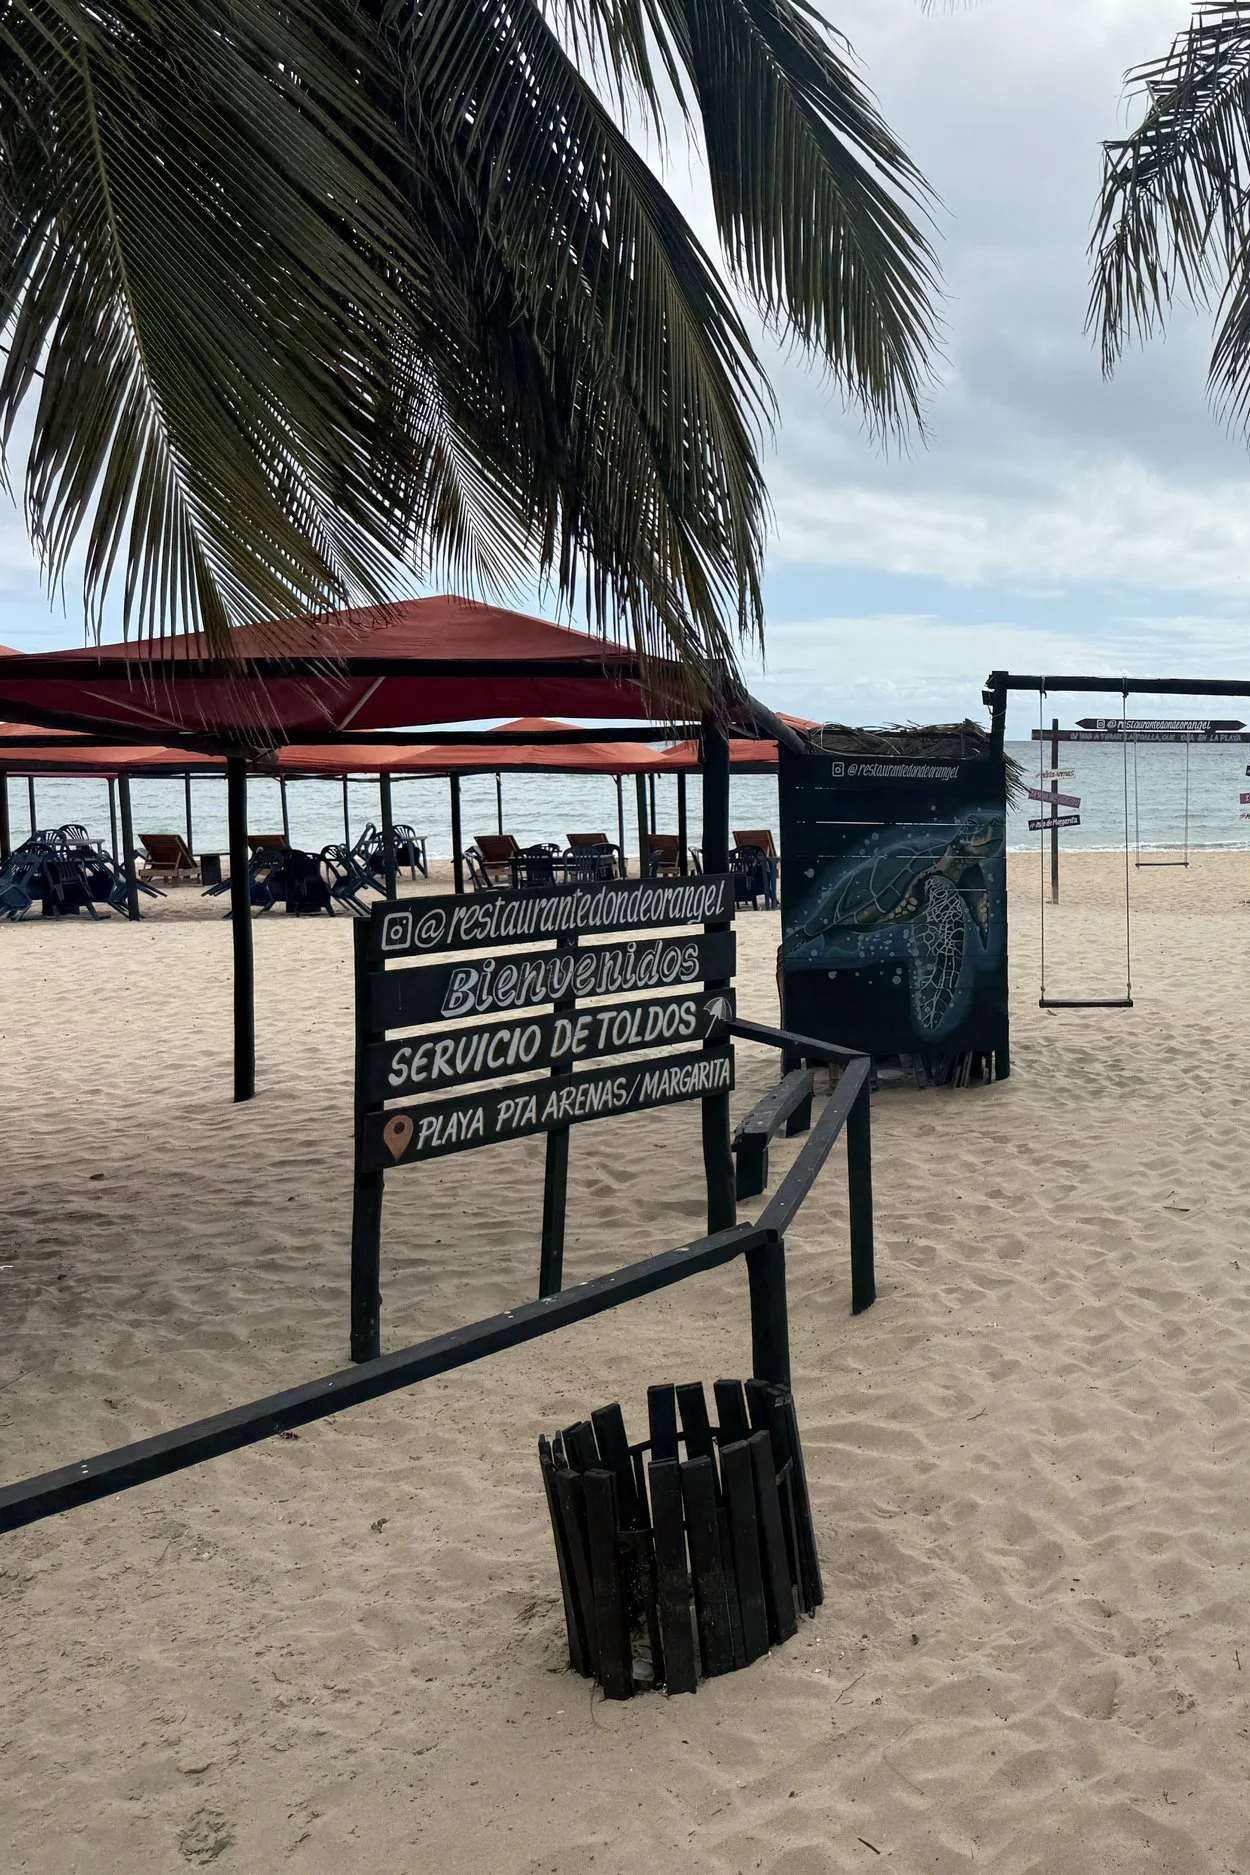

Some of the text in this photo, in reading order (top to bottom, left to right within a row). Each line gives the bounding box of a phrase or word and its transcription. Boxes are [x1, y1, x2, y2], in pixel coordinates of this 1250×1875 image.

[1106, 720, 1212, 731] @restaurantedondeorangel
[847, 763, 960, 781] @restaurantedondeorangel
[414, 879, 725, 948] @restaurantedondeorangel
[441, 940, 700, 1018] Bienvenidos
[388, 1001, 698, 1087] SERVICIO DE TOLDOS
[416, 1107, 484, 1150] PLAYA
[496, 1095, 537, 1132] PTA
